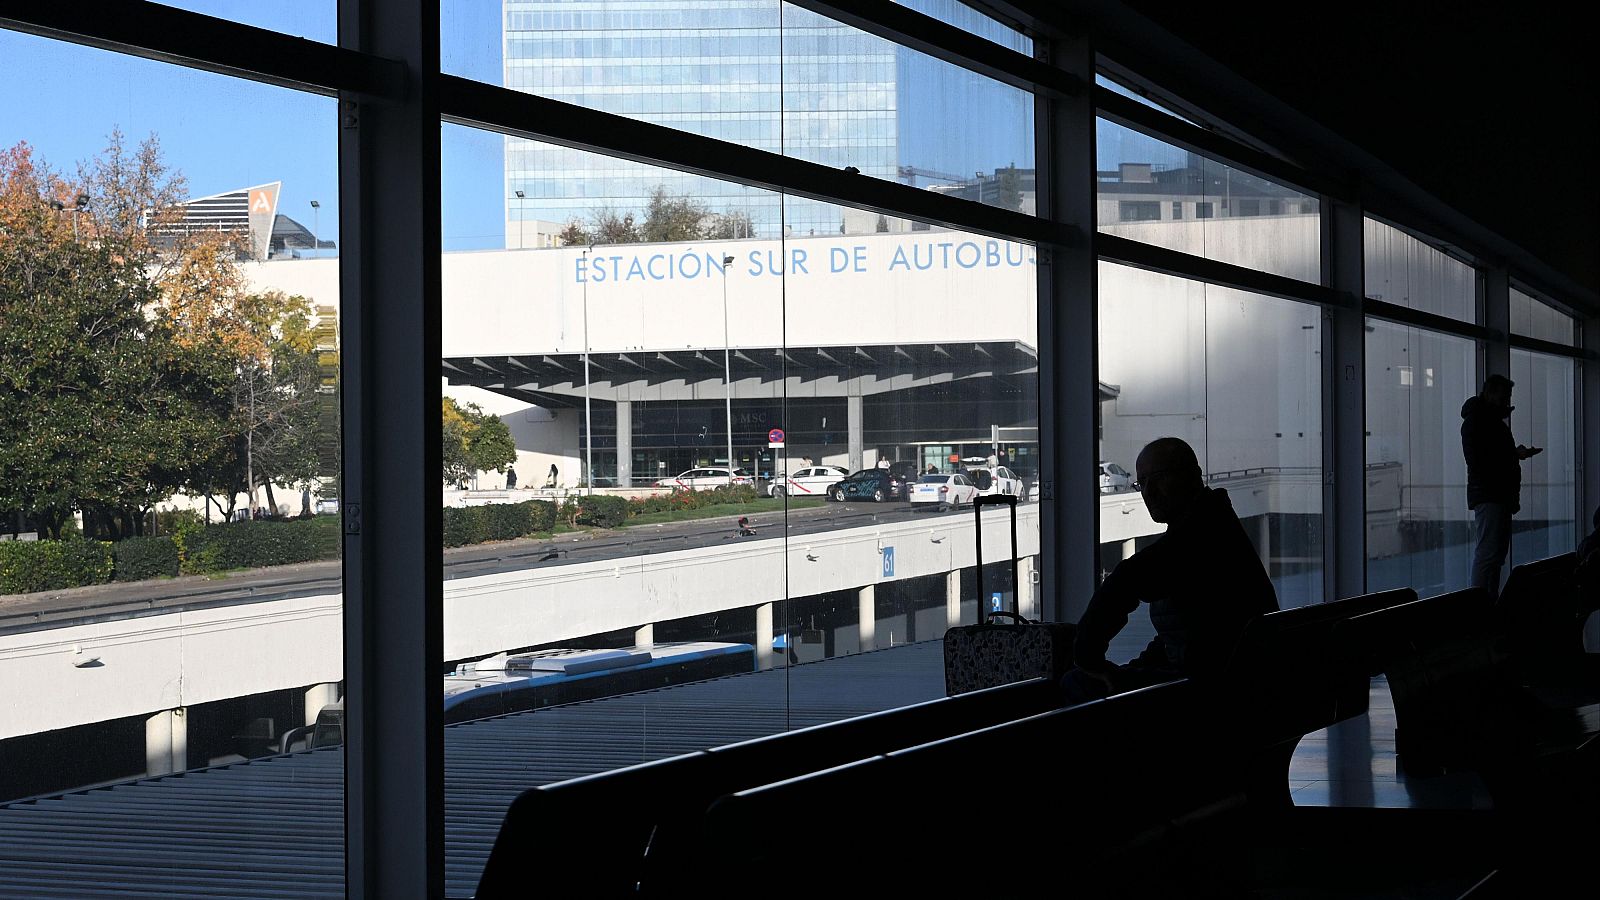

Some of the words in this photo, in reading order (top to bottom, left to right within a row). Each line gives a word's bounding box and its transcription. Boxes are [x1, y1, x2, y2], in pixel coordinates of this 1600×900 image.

[576, 247, 724, 283] ESTACIÓN
[748, 246, 809, 276] SUR
[829, 246, 867, 274] DE
[884, 553, 893, 573] 61
